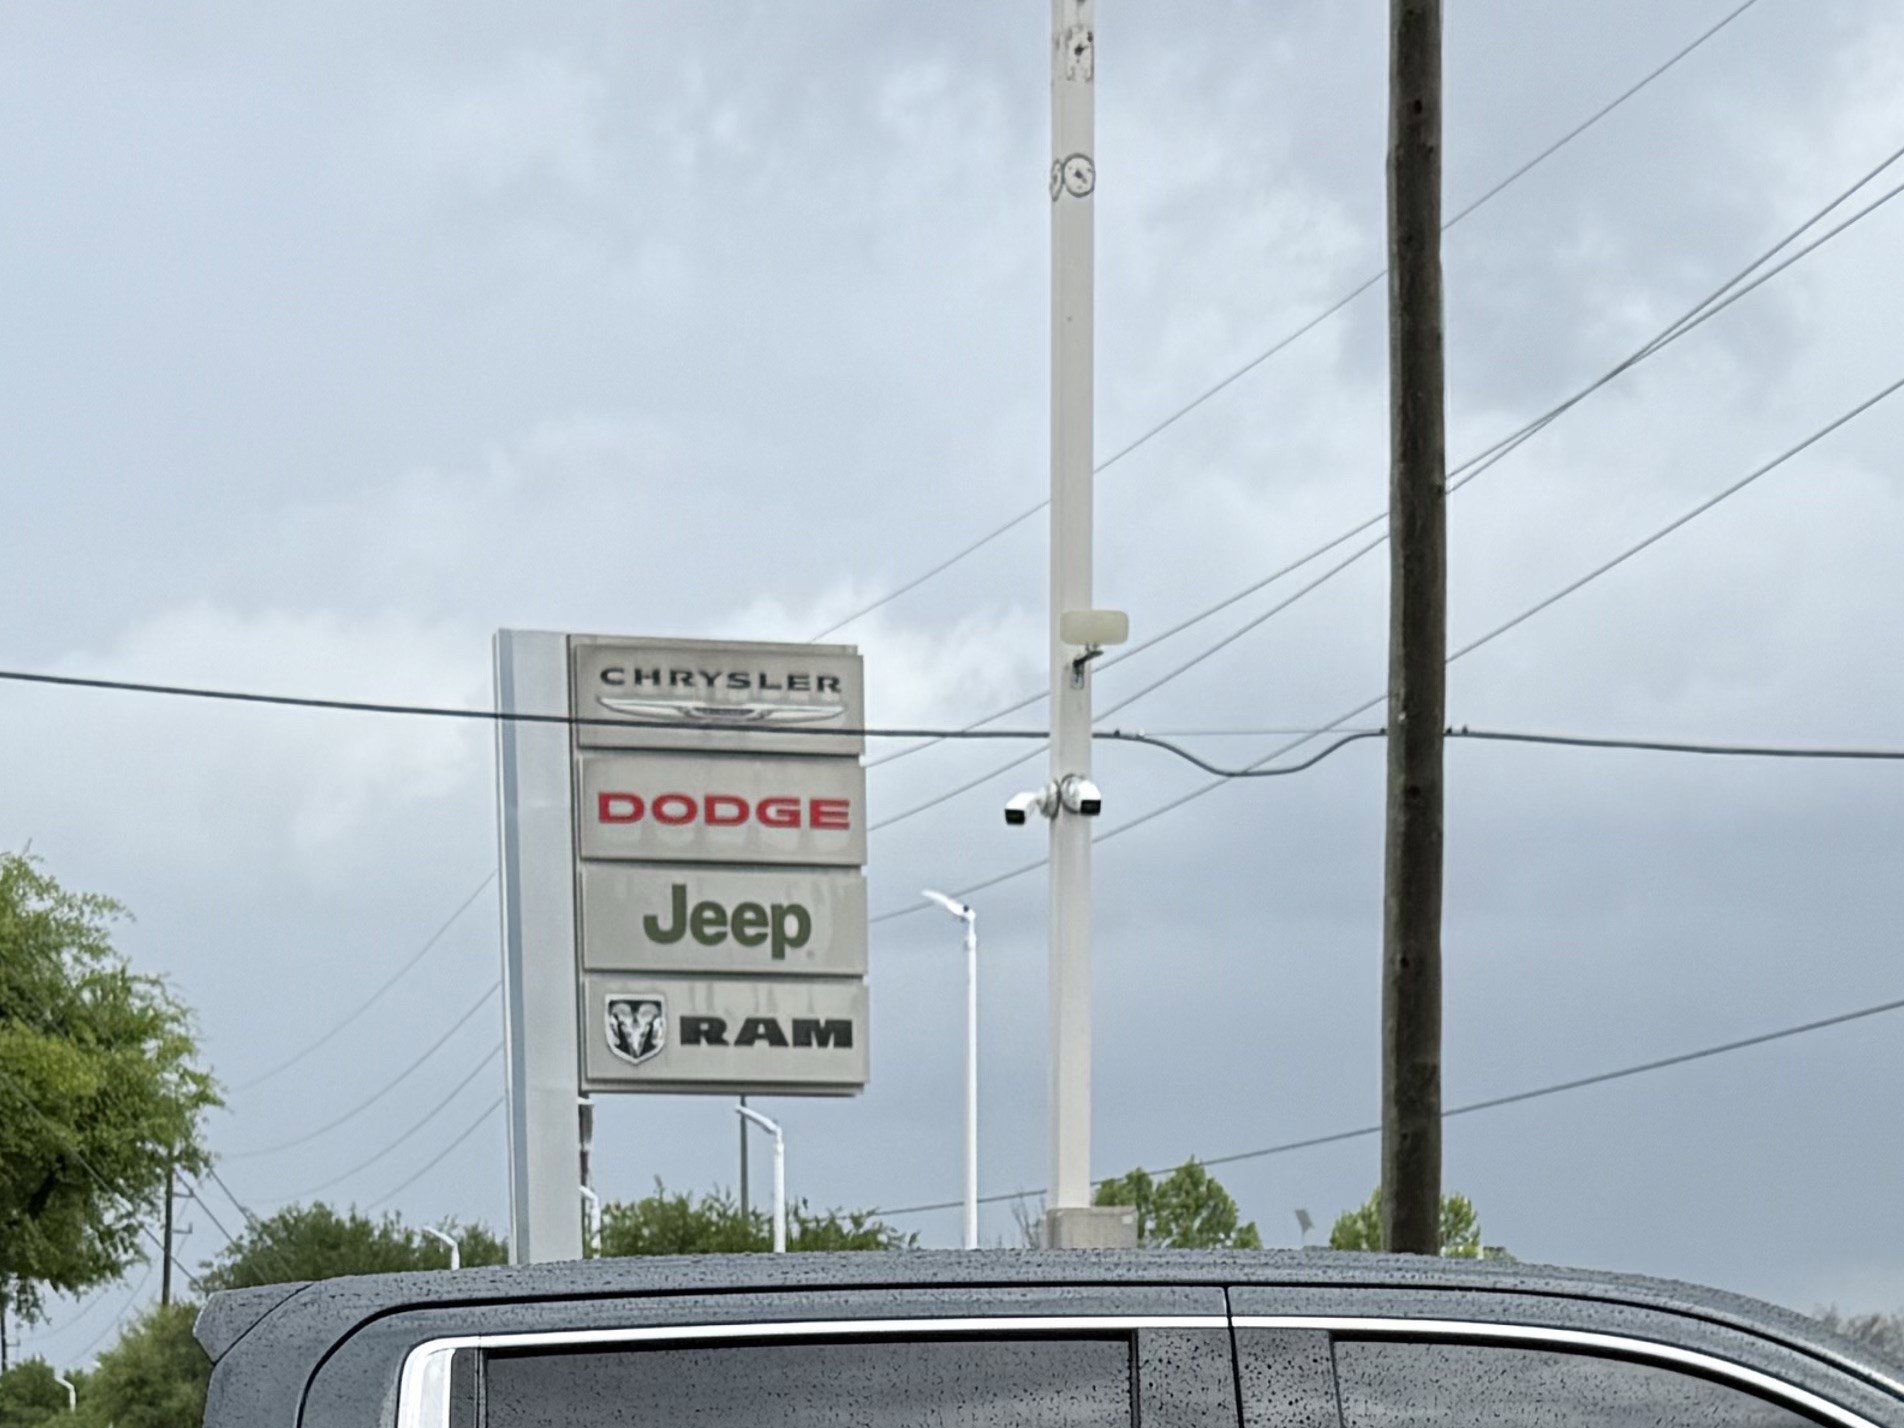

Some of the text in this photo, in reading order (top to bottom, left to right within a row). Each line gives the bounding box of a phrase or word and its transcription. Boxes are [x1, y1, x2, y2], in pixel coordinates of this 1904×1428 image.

[599, 667, 842, 693] CHRYSLER
[597, 791, 851, 830] DODGE
[643, 883, 812, 960] Jeep
[680, 1015, 853, 1049] RAM
